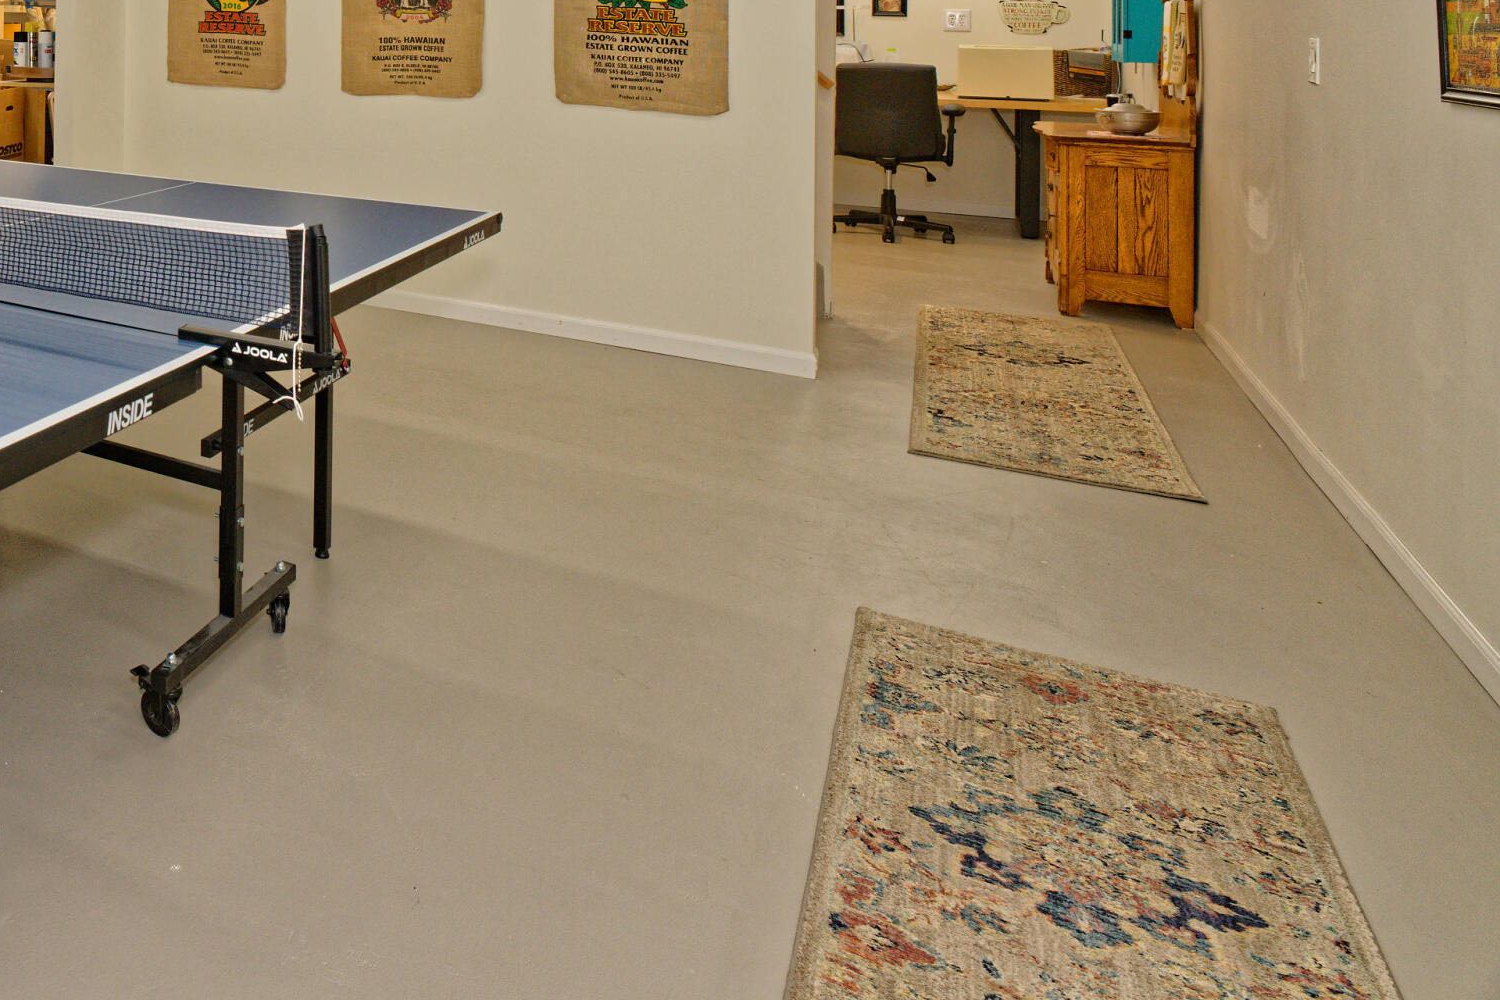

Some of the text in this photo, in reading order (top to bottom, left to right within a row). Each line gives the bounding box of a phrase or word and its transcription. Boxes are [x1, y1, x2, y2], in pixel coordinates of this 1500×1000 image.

[222, 2, 242, 10] 2016
[204, 10, 260, 23] ESTATE
[596, 5, 678, 23] ESTATE
[198, 21, 267, 36] RESERVE
[587, 18, 688, 38] RESERVE
[379, 36, 446, 45] 100% HAWAIIAN
[586, 34, 689, 47] 100% HAWAIIAN
[379, 44, 399, 52] ESTATE
[585, 42, 688, 55] ESTATE GROWN COFFEE
[419, 55, 453, 63] COMPANY
[645, 57, 684, 66] COMPANY
[242, 345, 288, 364] JOOLA
[319, 367, 342, 391] JOOLA
[106, 392, 154, 436] INSIDE
